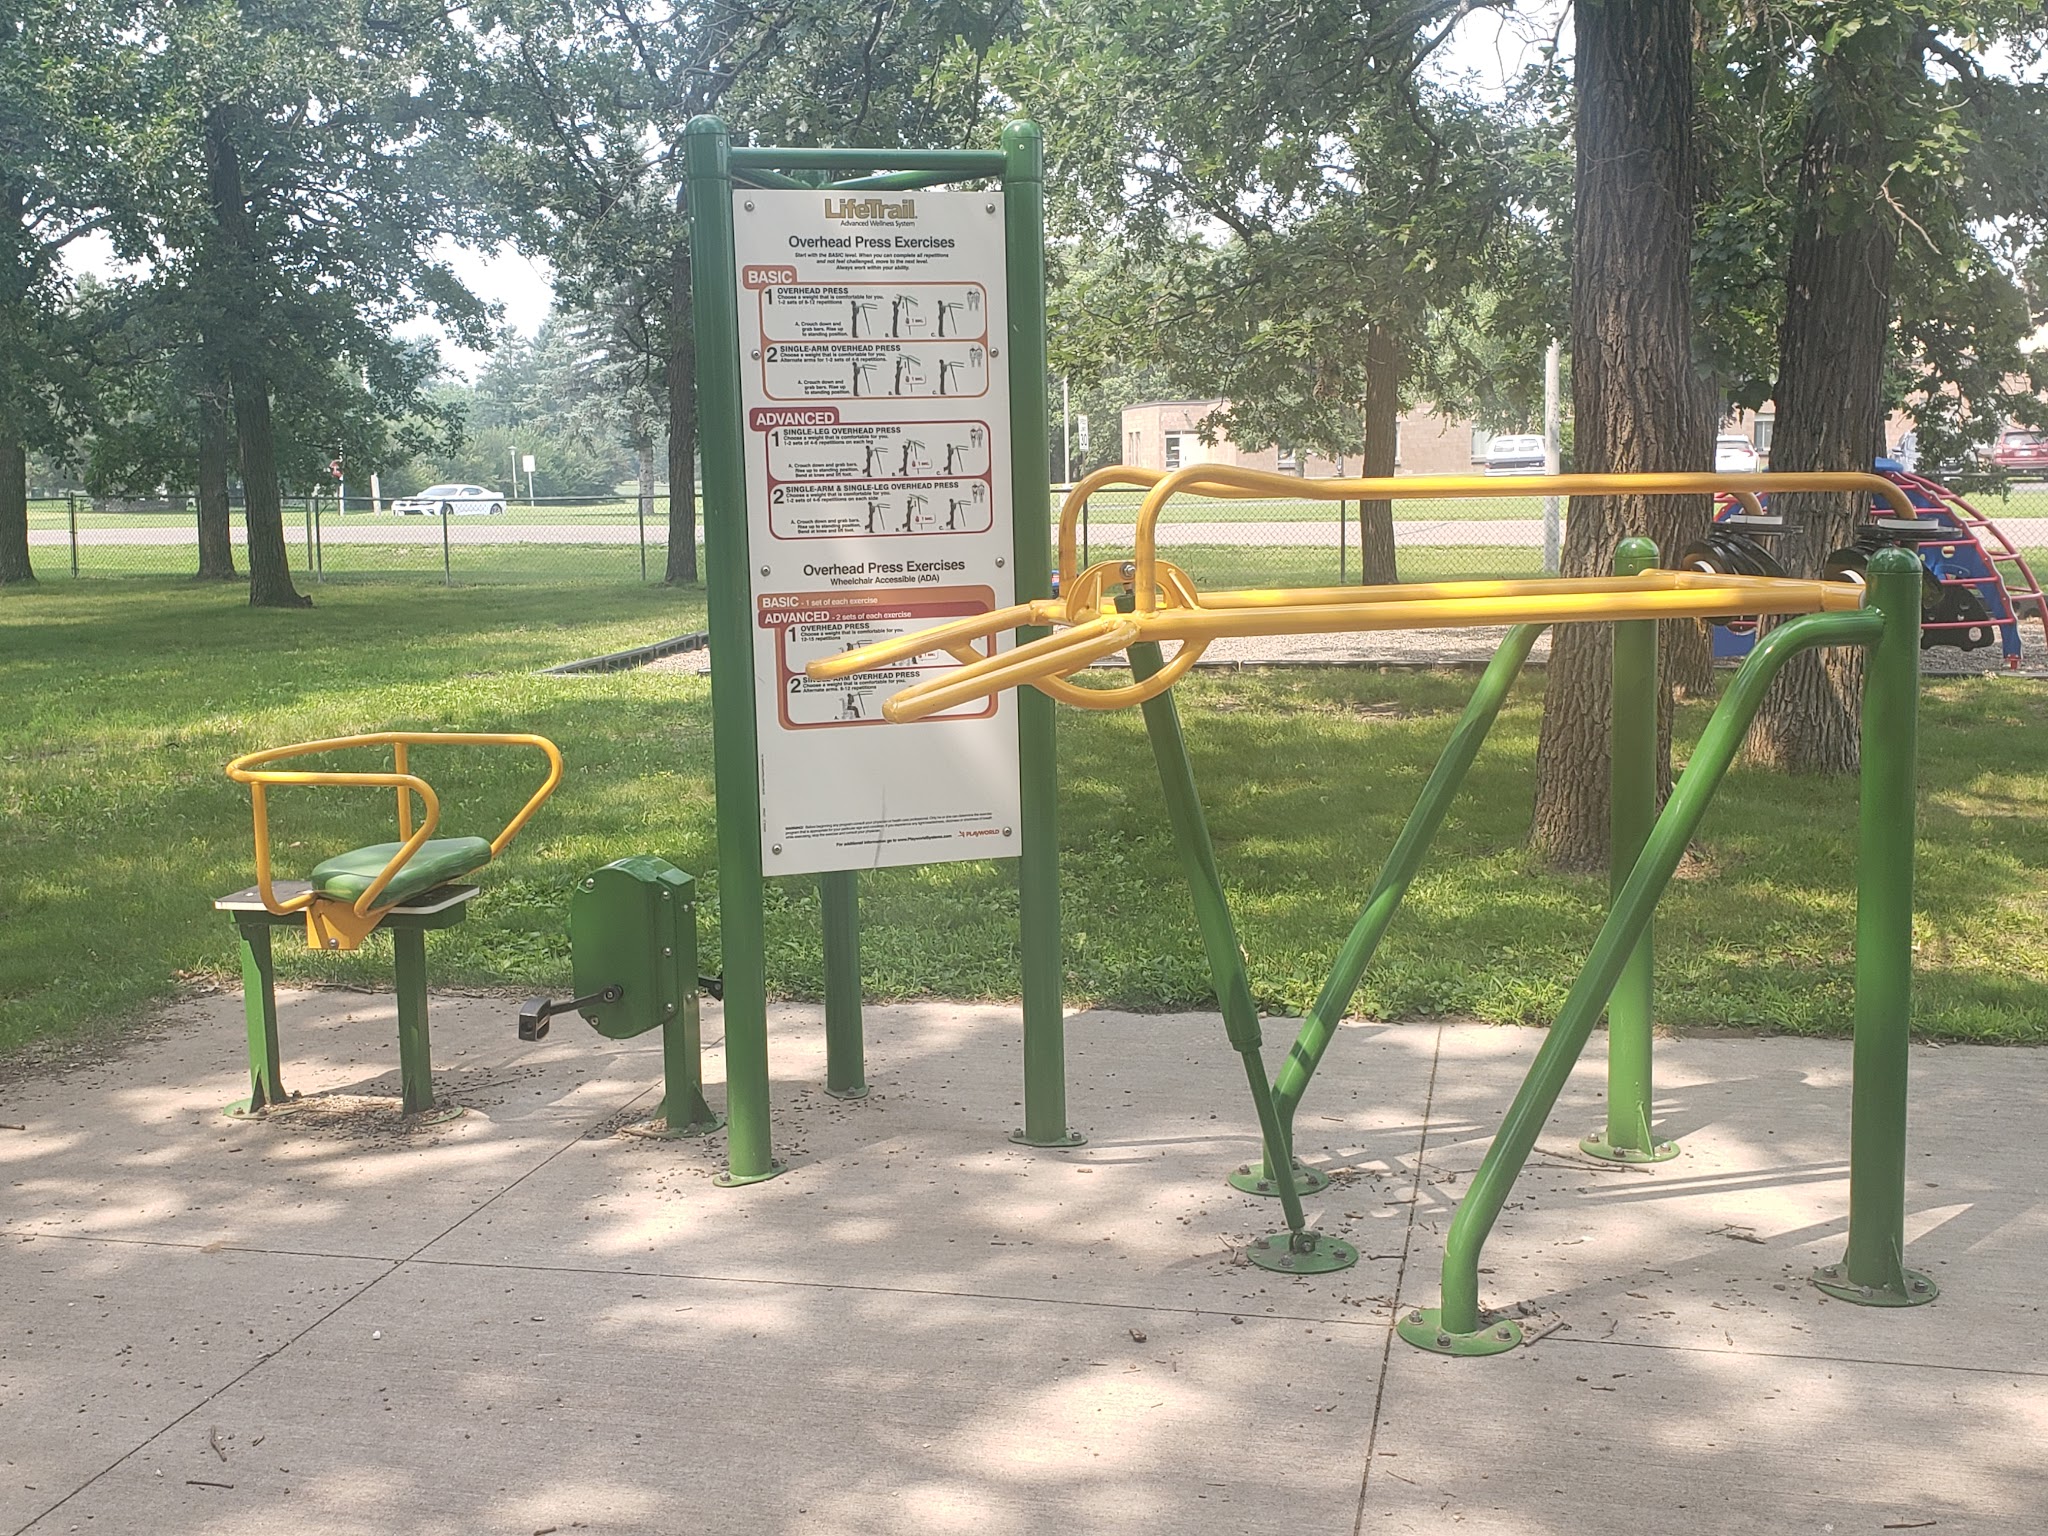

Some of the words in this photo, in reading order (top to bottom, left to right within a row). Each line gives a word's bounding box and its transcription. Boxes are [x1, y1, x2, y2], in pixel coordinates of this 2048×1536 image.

[824, 198, 915, 219] LifeTrail
[789, 236, 851, 248] Overhead
[855, 236, 891, 248] Press
[895, 236, 955, 248] Exercises
[748, 271, 792, 284] BASIC
[765, 289, 772, 304] 1
[767, 347, 778, 362] 2
[756, 412, 834, 425] ADVANCED
[771, 431, 779, 446] 1
[773, 489, 784, 504] 2
[803, 563, 864, 576] Overhead
[868, 562, 903, 574] Press
[906, 559, 965, 572] Exercises
[830, 577, 873, 585] Wheelchair
[875, 575, 915, 584] Accessible
[918, 574, 939, 583] (ADA)
[762, 596, 799, 608] BASIC
[765, 611, 829, 624] ADVANCED
[788, 627, 796, 642] 1
[852, 672, 893, 680] OVERHEAD
[790, 678, 801, 693] 2
